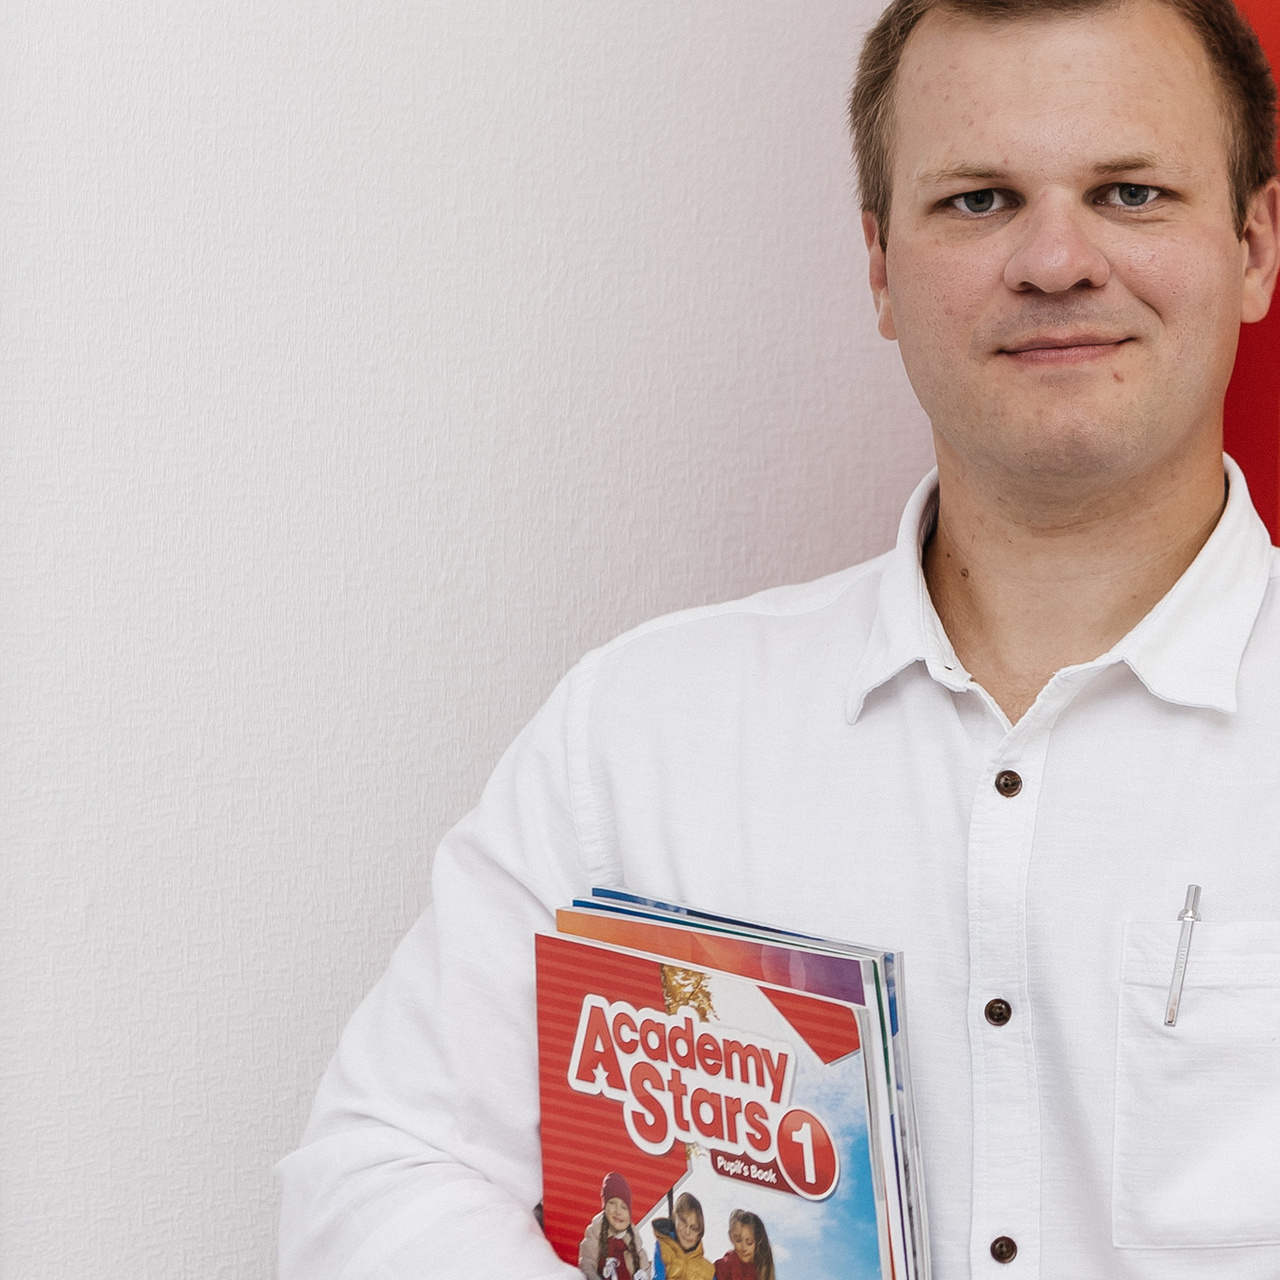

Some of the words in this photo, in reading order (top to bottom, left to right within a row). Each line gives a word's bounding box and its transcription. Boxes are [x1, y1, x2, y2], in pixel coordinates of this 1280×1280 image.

[575, 1004, 789, 1104] Academy
[629, 1060, 772, 1152] Stars
[791, 1121, 817, 1184] 1
[716, 1155, 749, 1176] Pupil's
[749, 1164, 777, 1184] Book
